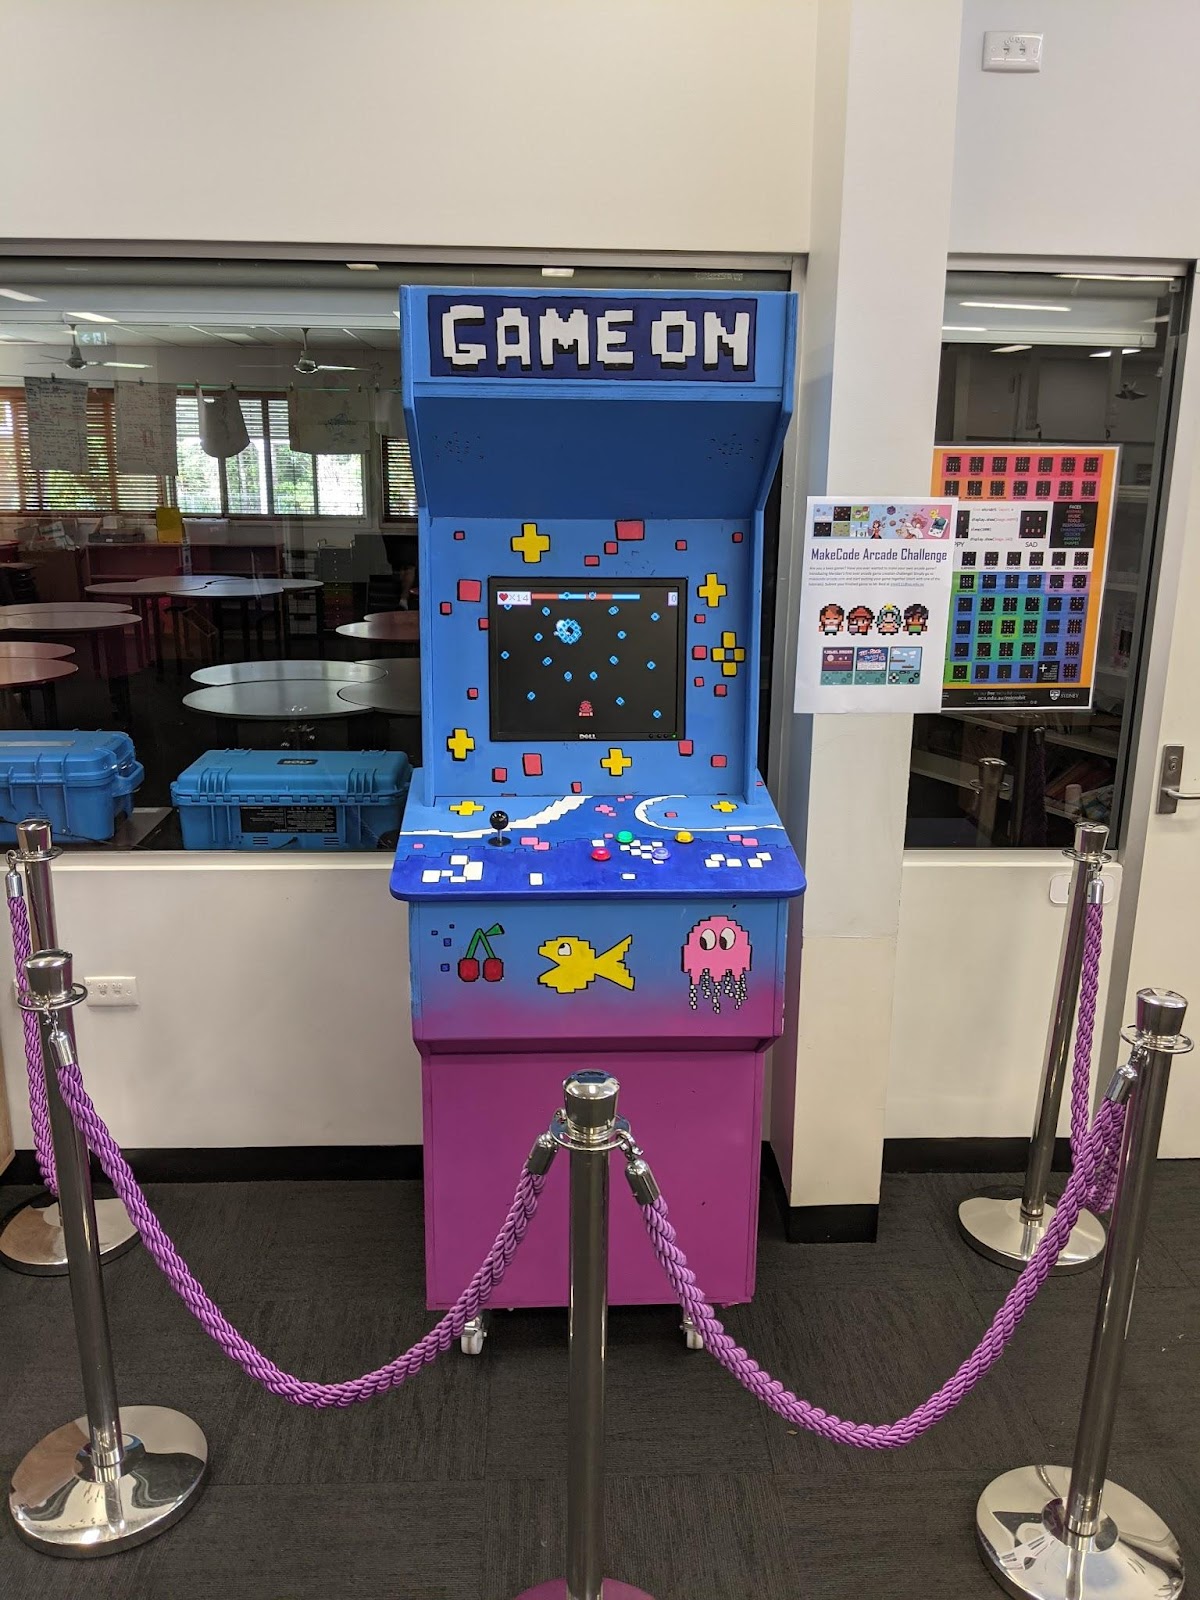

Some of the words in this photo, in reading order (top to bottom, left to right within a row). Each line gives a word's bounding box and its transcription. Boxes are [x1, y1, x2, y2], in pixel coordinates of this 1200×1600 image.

[442, 304, 635, 370] GAME
[650, 310, 749, 370] ON
[811, 548, 860, 560] MakeCode
[862, 548, 898, 560] Arcade
[901, 548, 947, 563] Challenge
